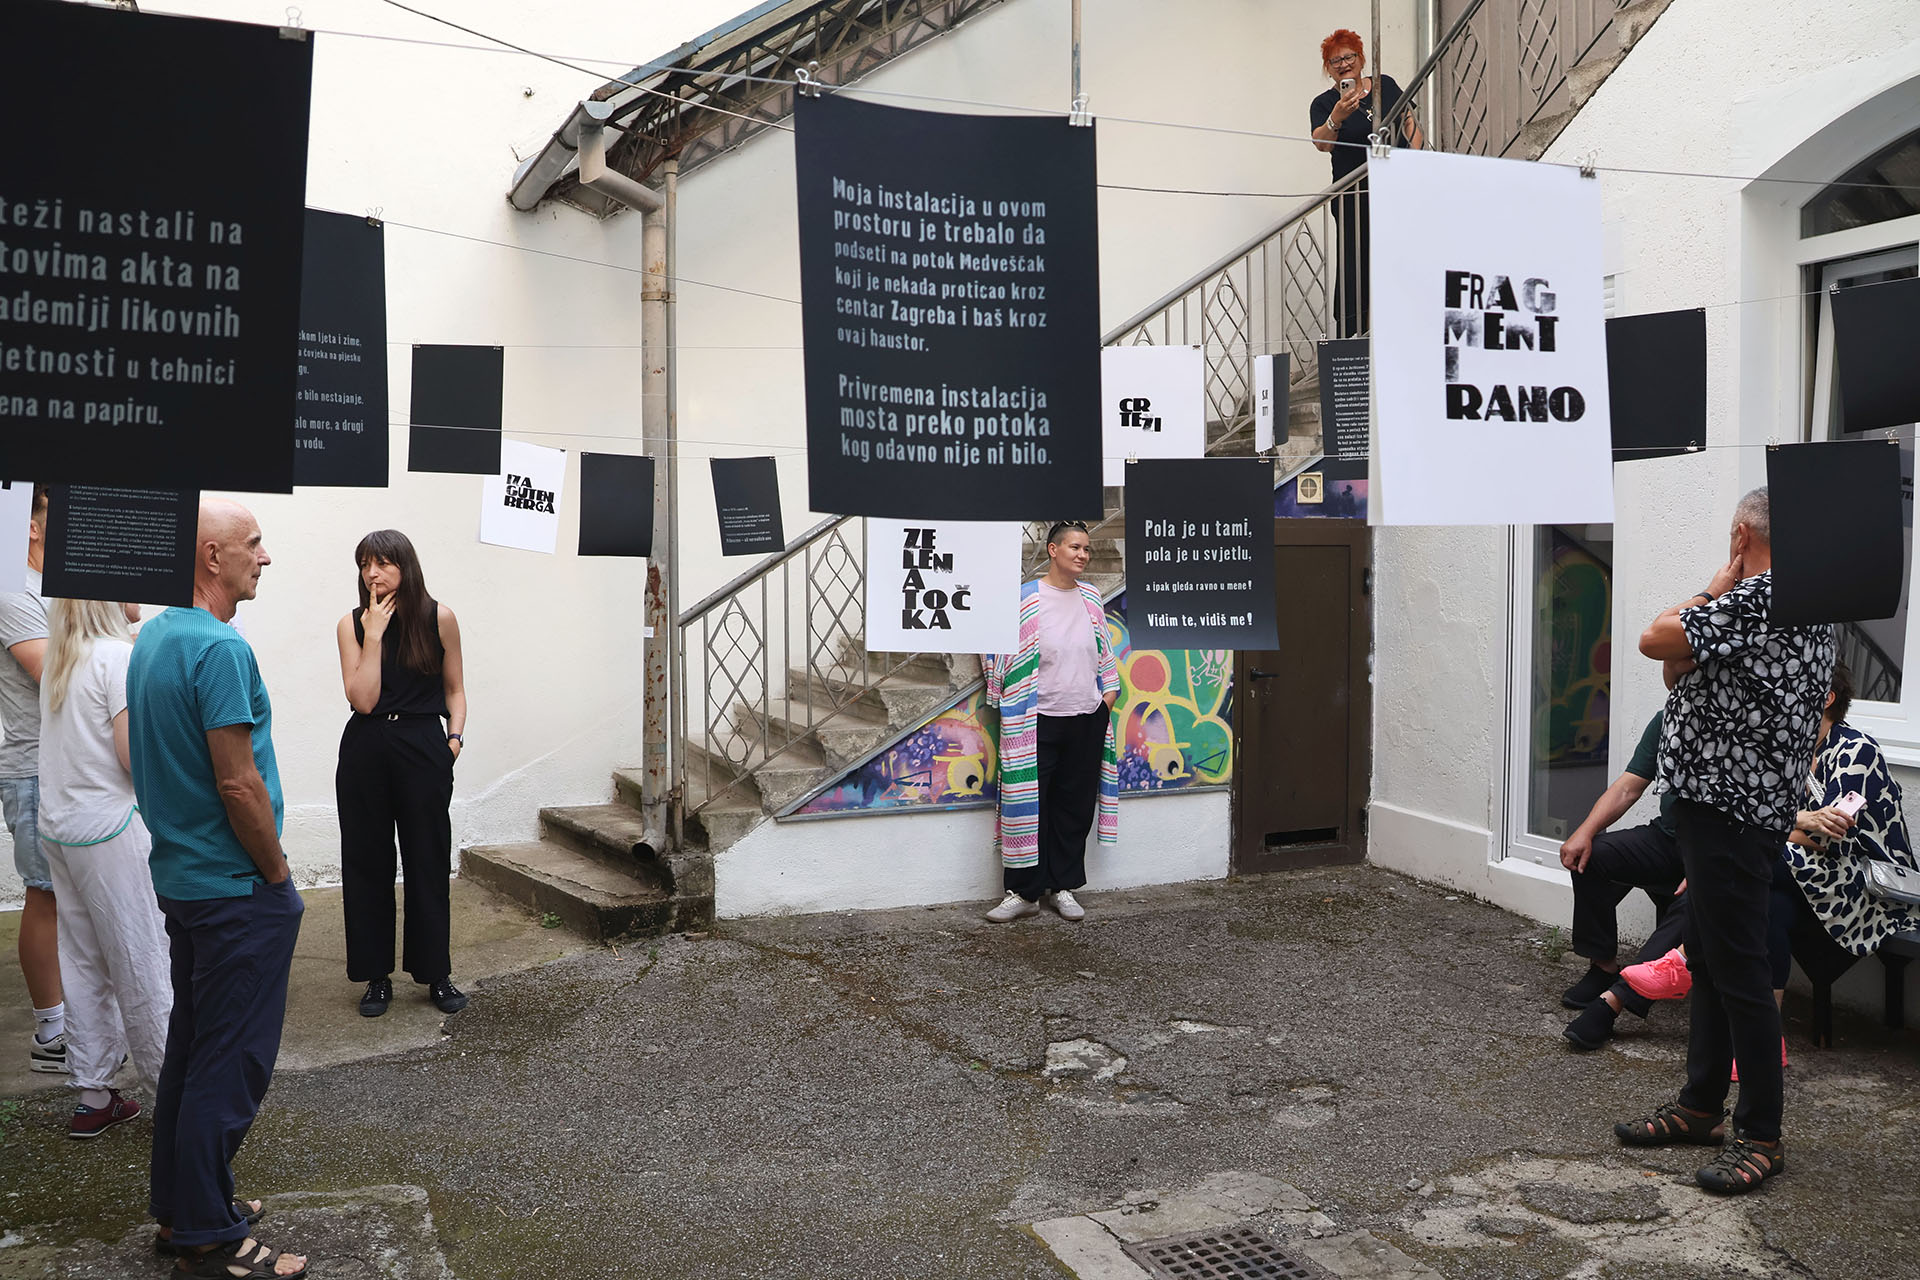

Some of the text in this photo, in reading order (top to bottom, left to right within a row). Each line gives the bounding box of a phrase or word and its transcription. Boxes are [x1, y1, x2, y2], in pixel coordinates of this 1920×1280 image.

[833, 176, 1045, 217] Moja instalacija u ovom
[80, 210, 194, 241] nastali
[210, 222, 242, 244] na
[835, 210, 1045, 244] prostoru je trebalo da
[835, 241, 1044, 272] podseti na potok Medveščak
[122, 252, 192, 287] akta
[207, 265, 239, 290] na
[836, 266, 1044, 299] koji je nekada proticao kroz
[122, 298, 239, 337] likovnih
[837, 298, 1046, 327] centar Zagreba i baš kroz
[838, 328, 928, 351] ovaj haustor.
[128, 360, 138, 378] u
[151, 358, 234, 384] tehnici
[840, 374, 1046, 411] Privremena instalacija
[1119, 398, 1150, 412] CR
[1446, 384, 1585, 422] RANO
[49, 400, 74, 418] na
[85, 398, 163, 426] papiru.
[841, 407, 1049, 439] mosta preko potoka
[842, 433, 1051, 466] kog odavno nije ni bilo.
[904, 528, 936, 549] ZE
[1146, 518, 1252, 539] Pola je u tami,
[903, 549, 953, 573] LEN
[1146, 546, 1251, 563] pola je u svjetlu,
[902, 568, 926, 589] A
[1153, 582, 1169, 592] ipak
[1172, 582, 1193, 592] gleda
[902, 584, 971, 610] TOČ
[902, 609, 952, 629] KA
[1148, 614, 1178, 626] Vidim
[1182, 615, 1196, 627] te,
[1200, 613, 1226, 626] vidiš
